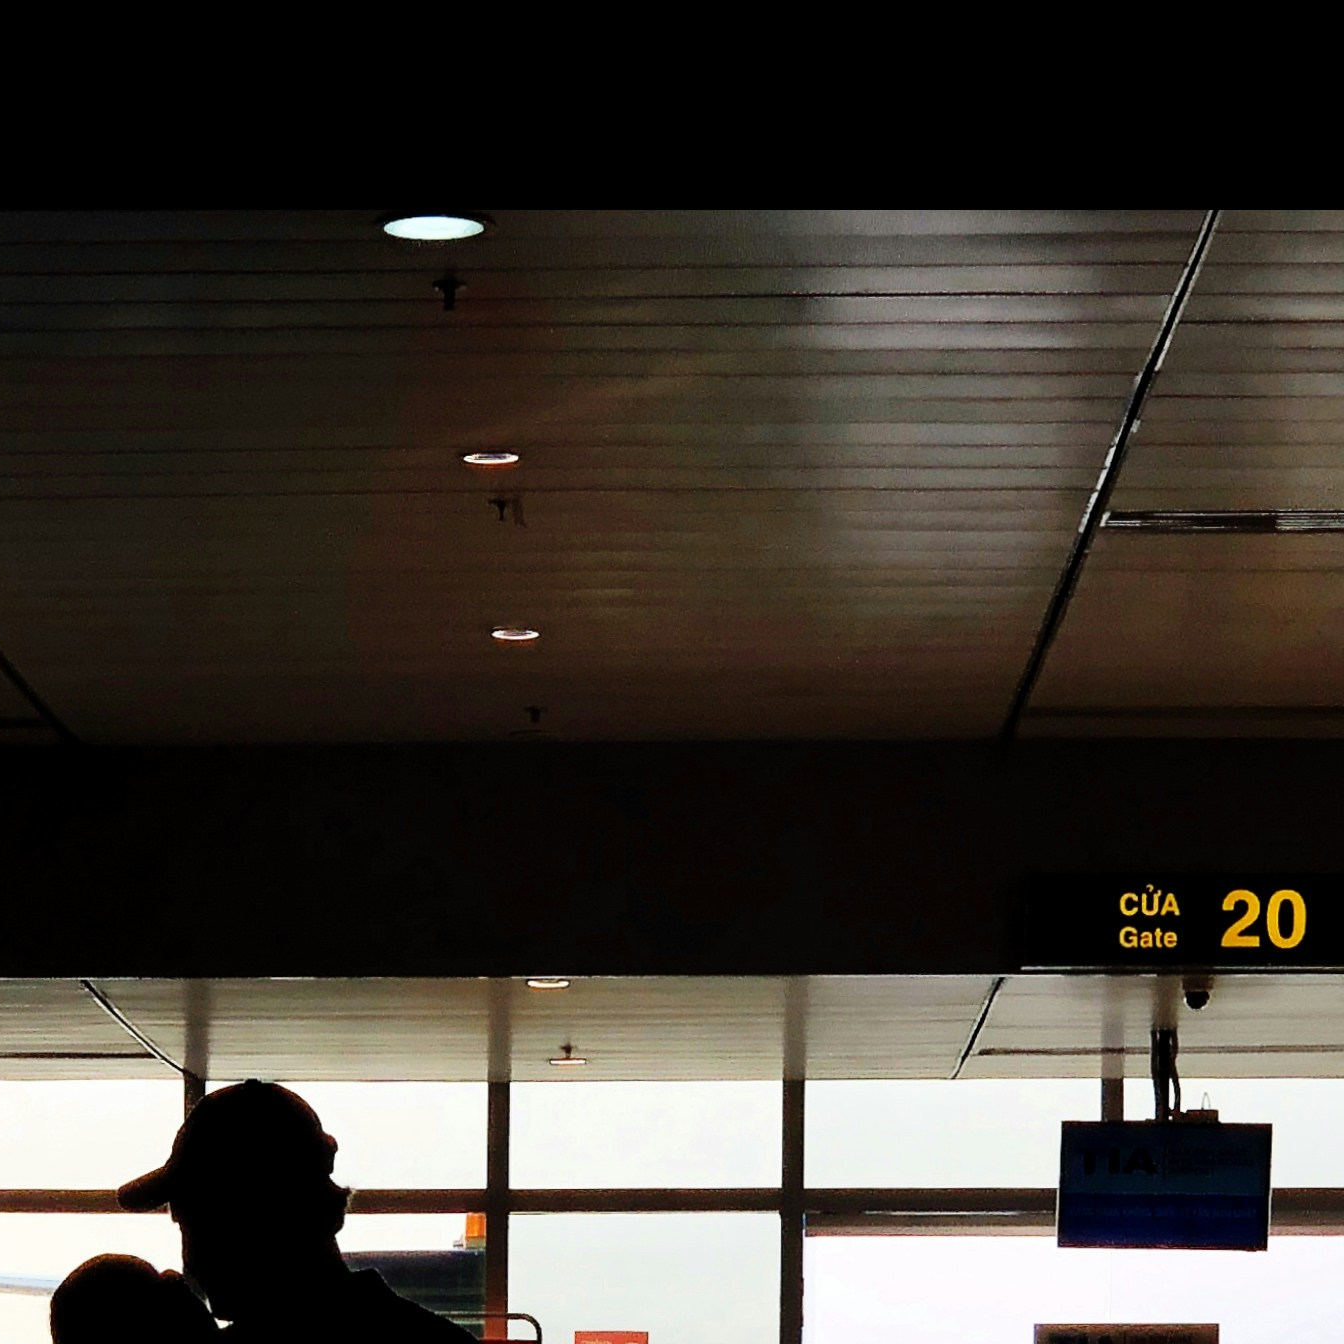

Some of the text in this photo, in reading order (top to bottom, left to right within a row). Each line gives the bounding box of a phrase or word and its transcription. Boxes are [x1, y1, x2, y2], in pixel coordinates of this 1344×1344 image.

[1119, 884, 1181, 917] CỬA
[1220, 888, 1308, 950] 20
[1118, 926, 1178, 949] Gate
